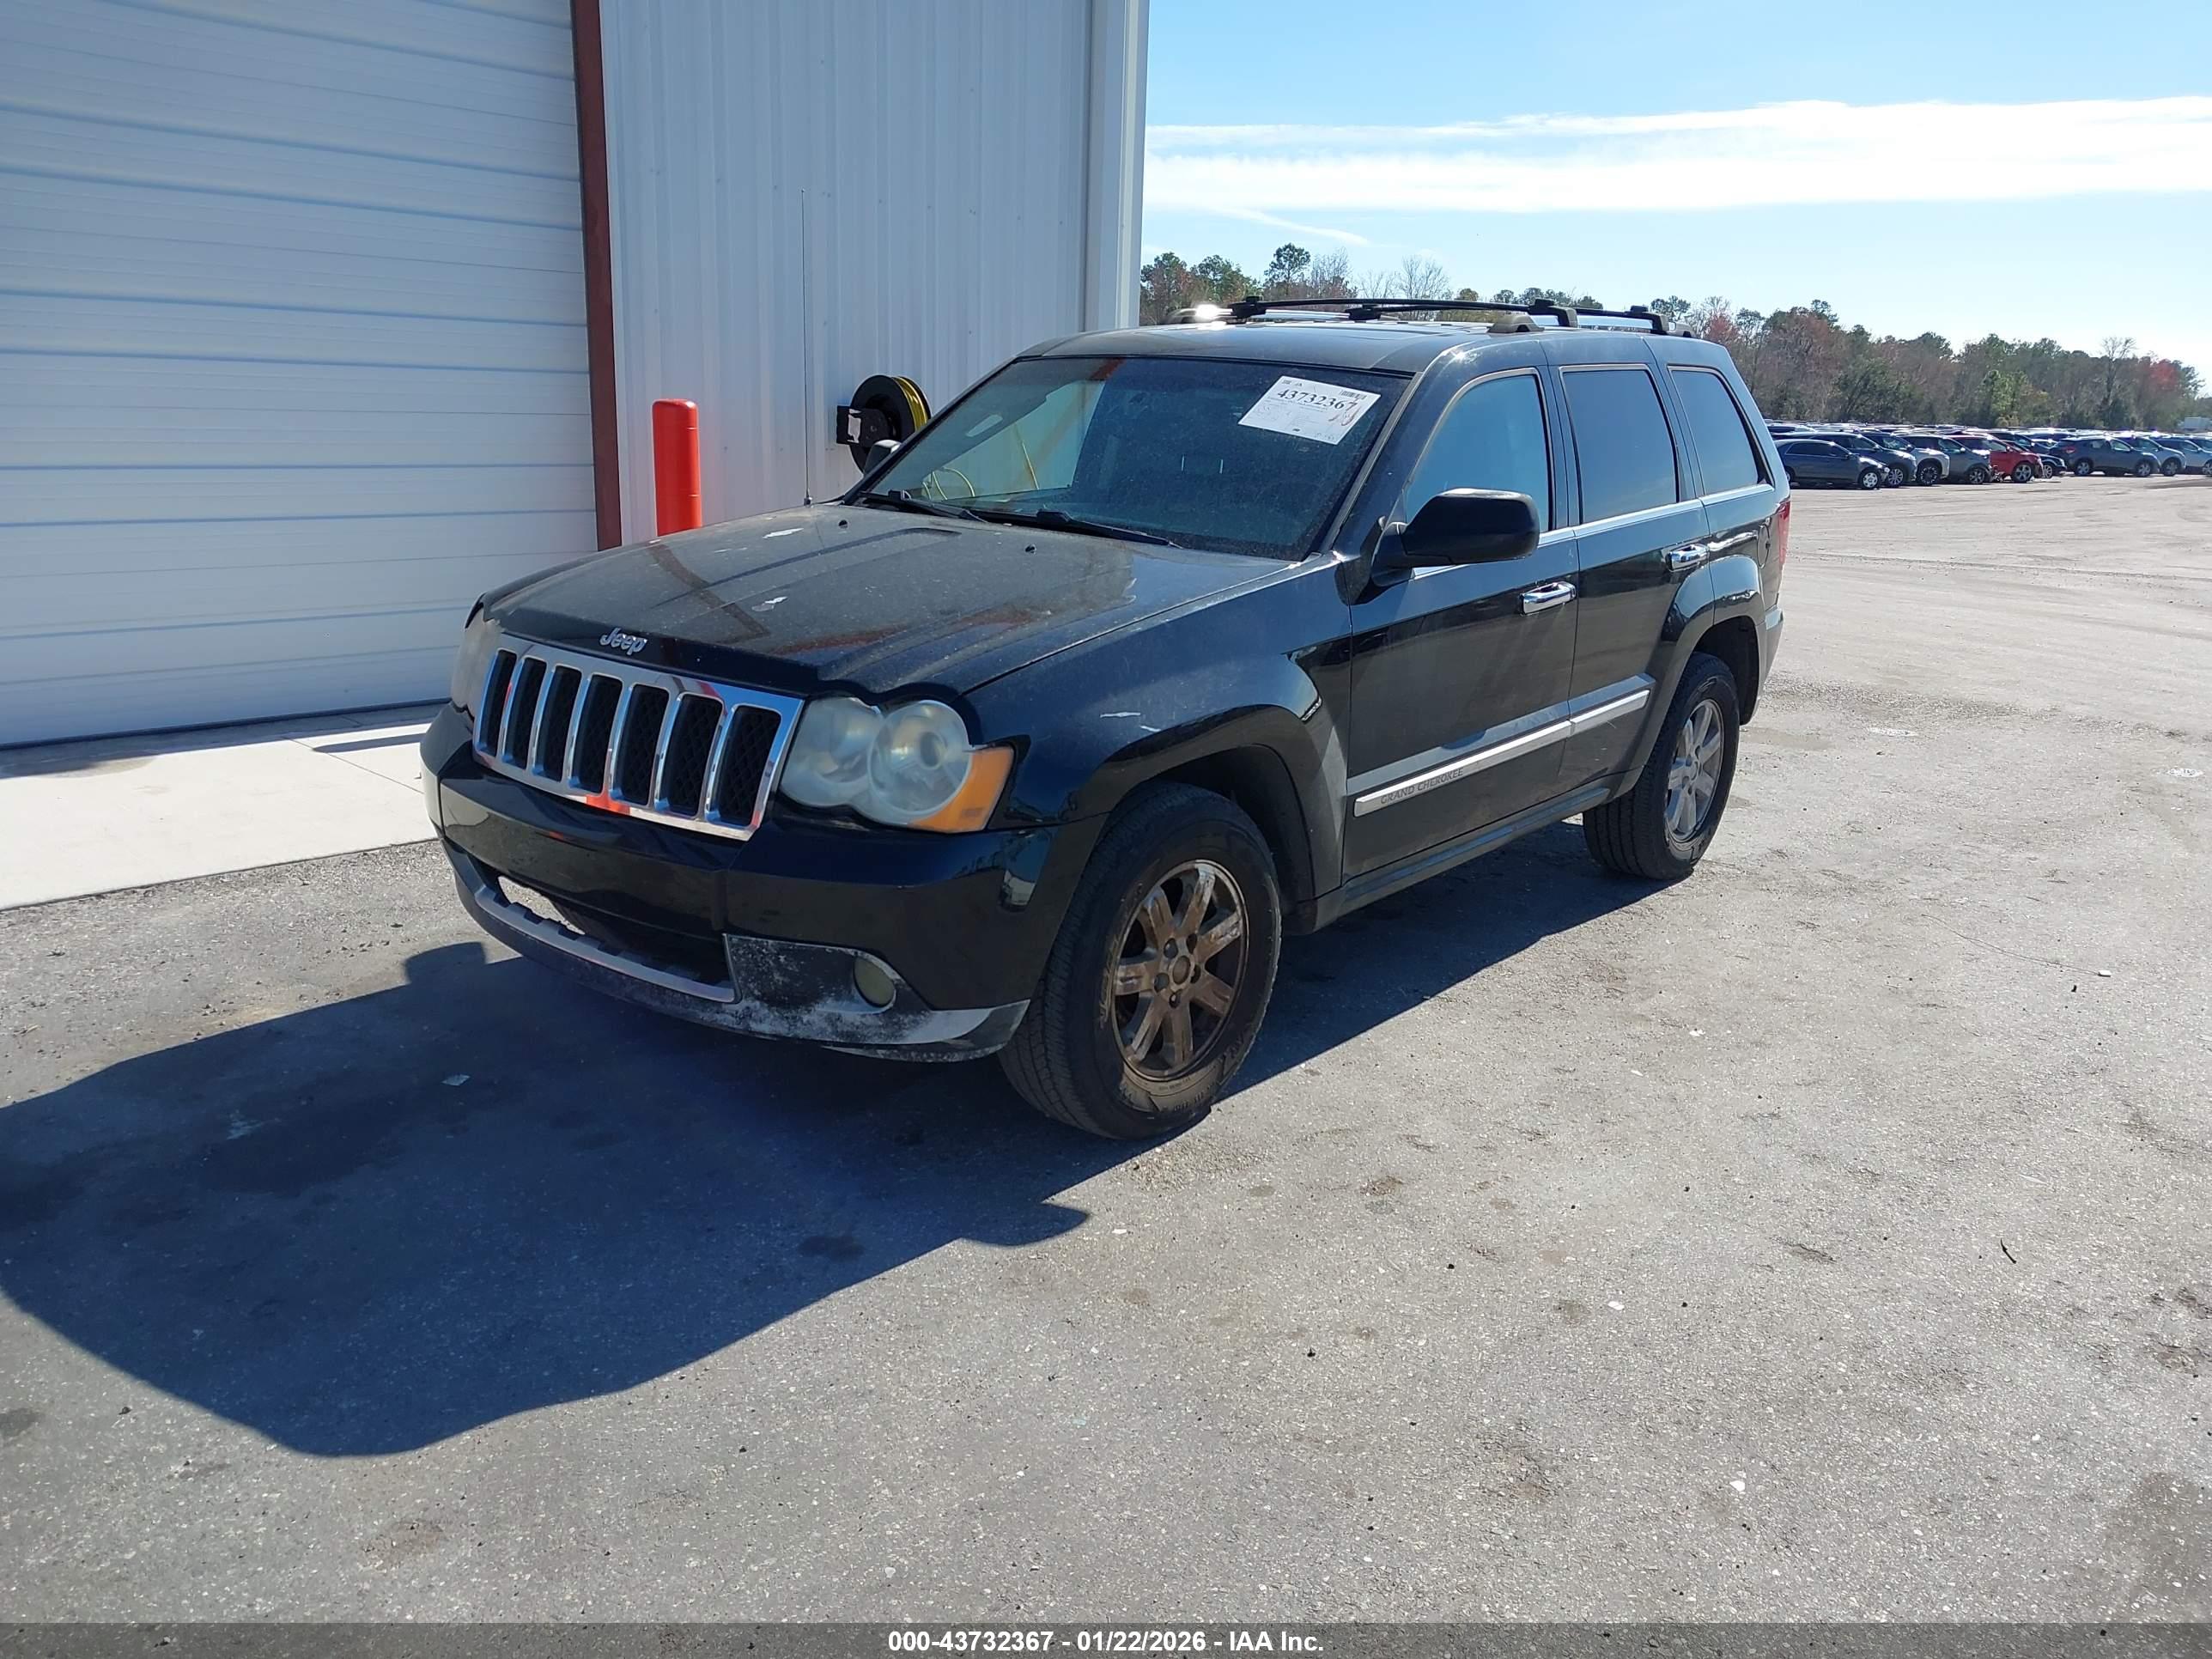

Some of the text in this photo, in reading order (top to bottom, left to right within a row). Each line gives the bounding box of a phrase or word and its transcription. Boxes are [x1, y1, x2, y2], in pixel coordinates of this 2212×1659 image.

[1277, 389, 1358, 411] 43732367
[599, 627, 647, 655] Jeep
[1380, 769, 1463, 805] GRAND CHEROKEE
